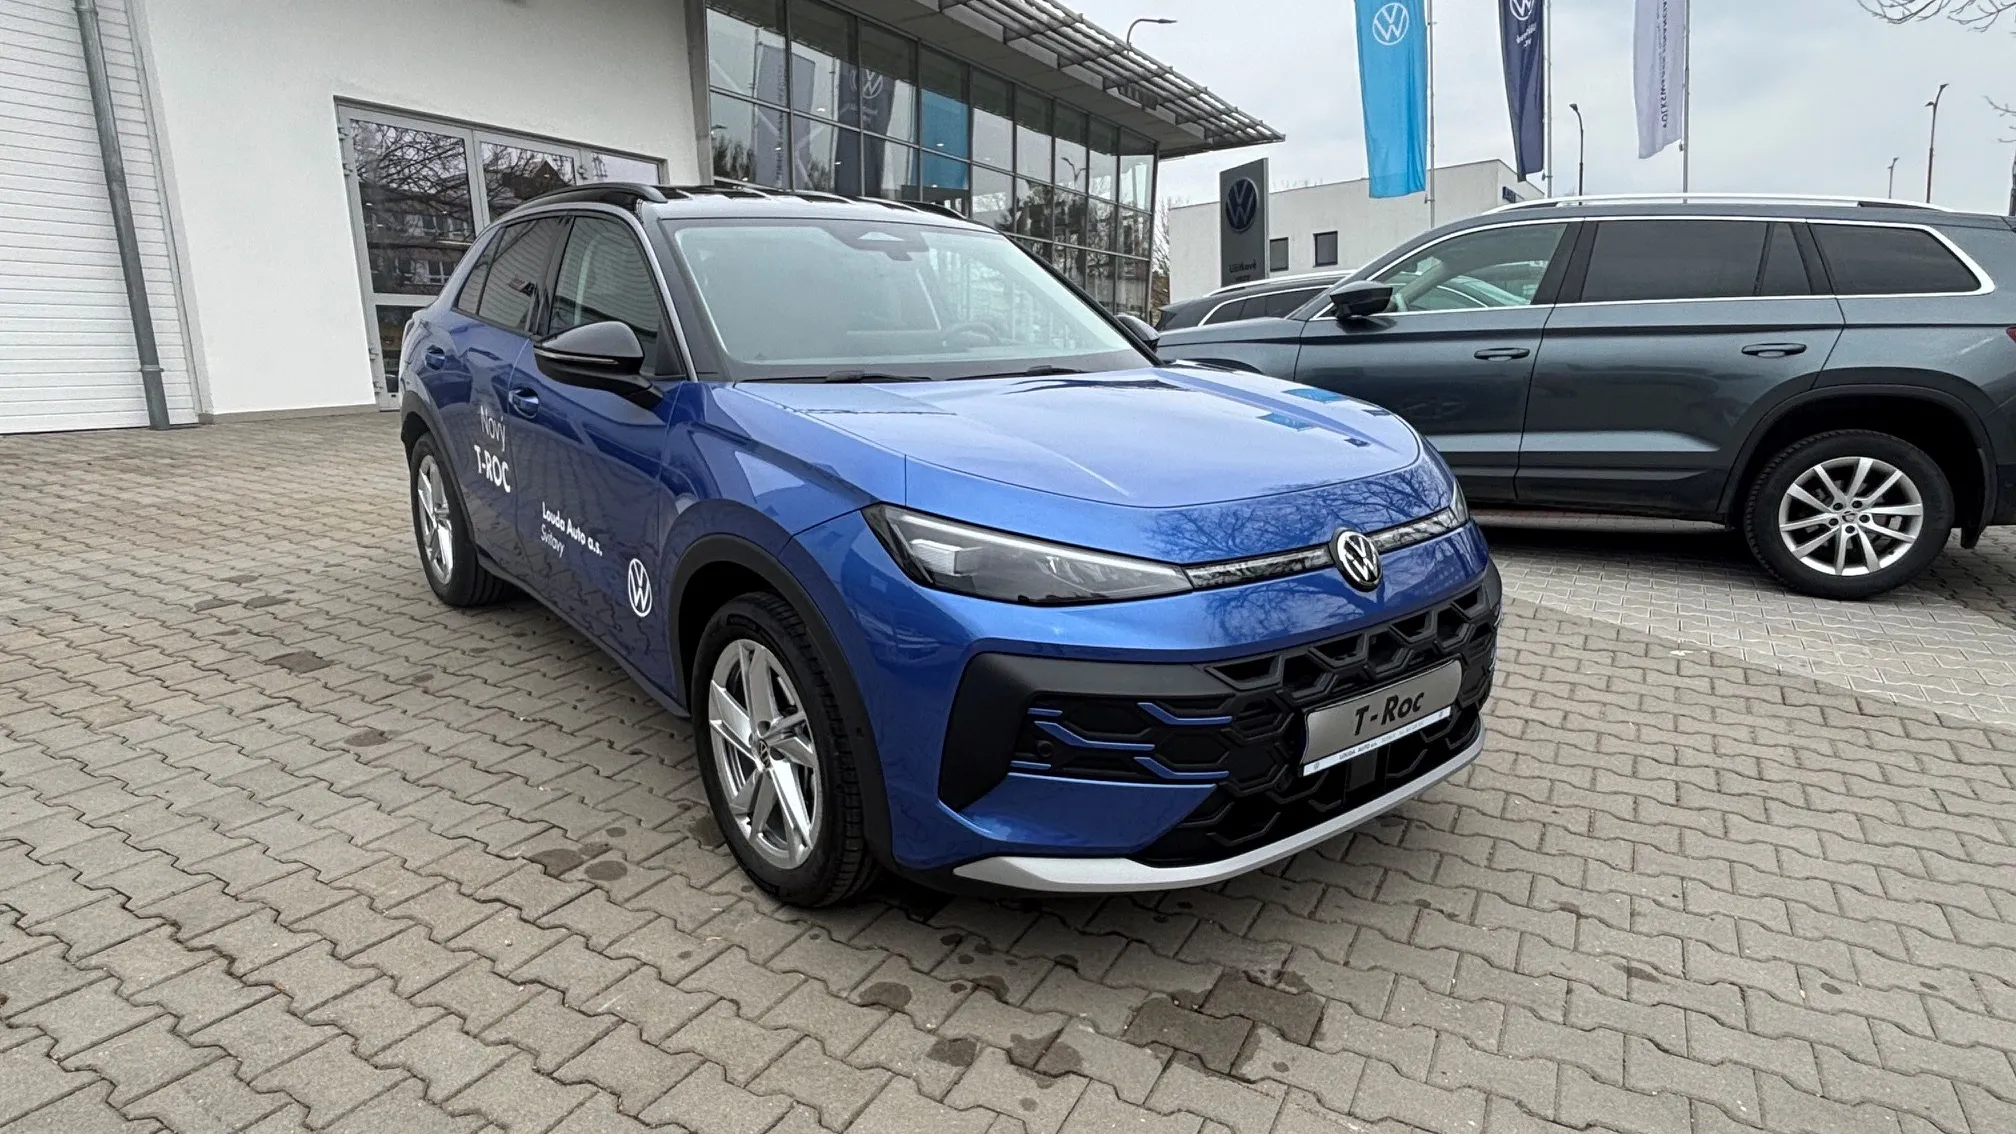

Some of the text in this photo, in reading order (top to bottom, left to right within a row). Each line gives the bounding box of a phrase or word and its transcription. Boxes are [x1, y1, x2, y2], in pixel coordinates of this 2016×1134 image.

[480, 405, 506, 452] Nový
[473, 444, 511, 493] T-ROC
[541, 524, 565, 558] Svitavy
[542, 501, 603, 556] Louda Auto a.s.
[1354, 692, 1425, 737] T-Roc
